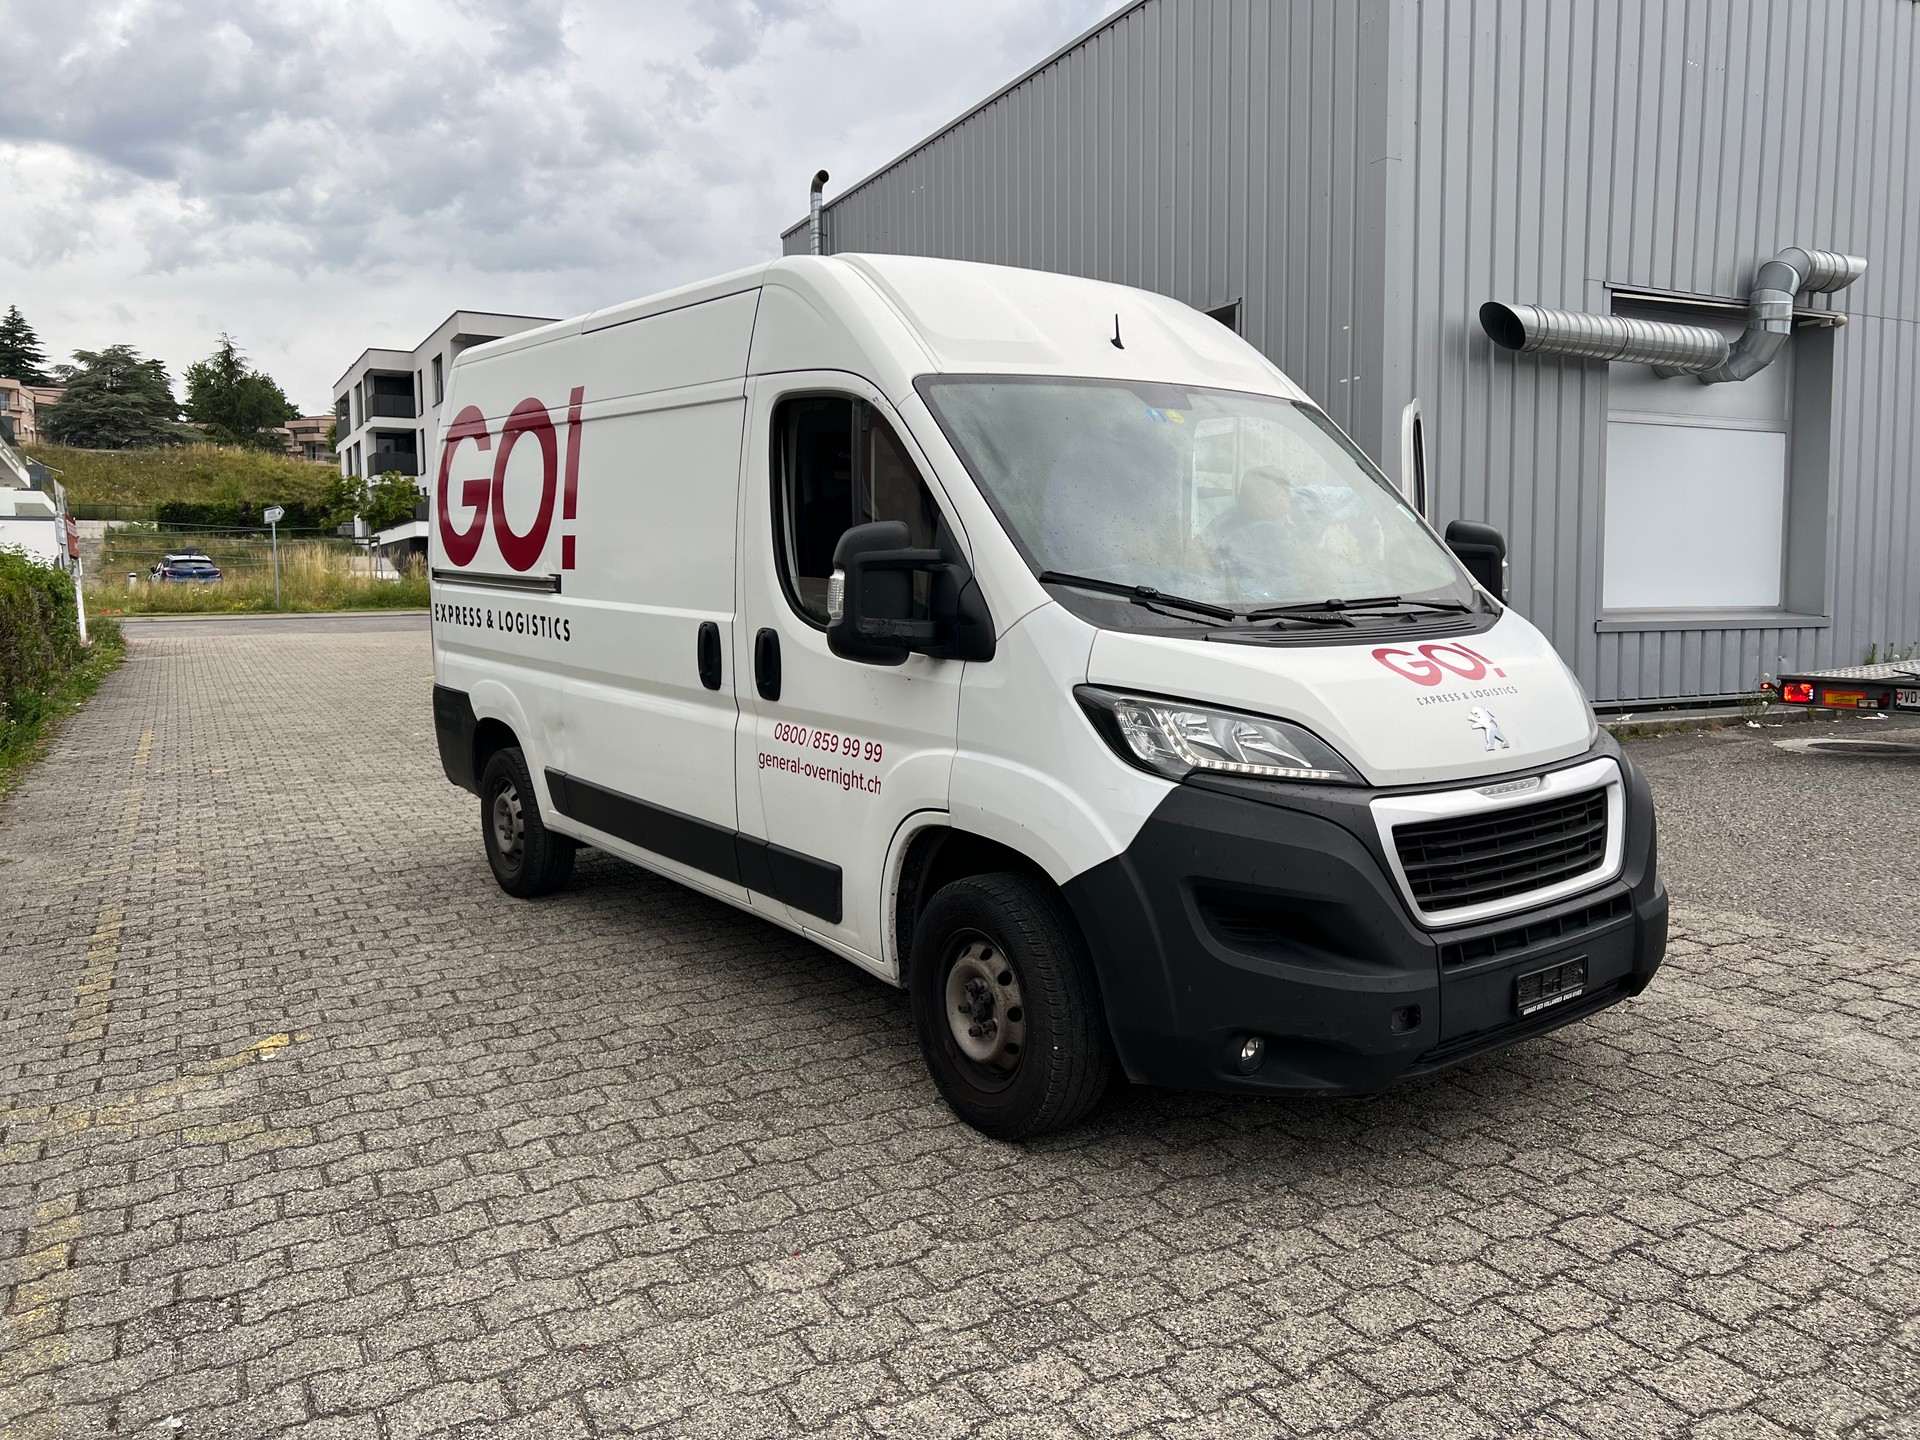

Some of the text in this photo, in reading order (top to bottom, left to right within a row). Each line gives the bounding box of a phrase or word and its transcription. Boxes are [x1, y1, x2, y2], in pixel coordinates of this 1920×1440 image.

[437, 386, 585, 571] GO!
[435, 602, 571, 642] EXPRESS & LOGISTICS
[1371, 643, 1506, 687] GO!
[1416, 692, 1461, 706] EXPRESS
[1471, 686, 1518, 699] LOGISTICS
[774, 722, 883, 763] 0800/859 99 99
[758, 752, 882, 795] general-overnight.ch
